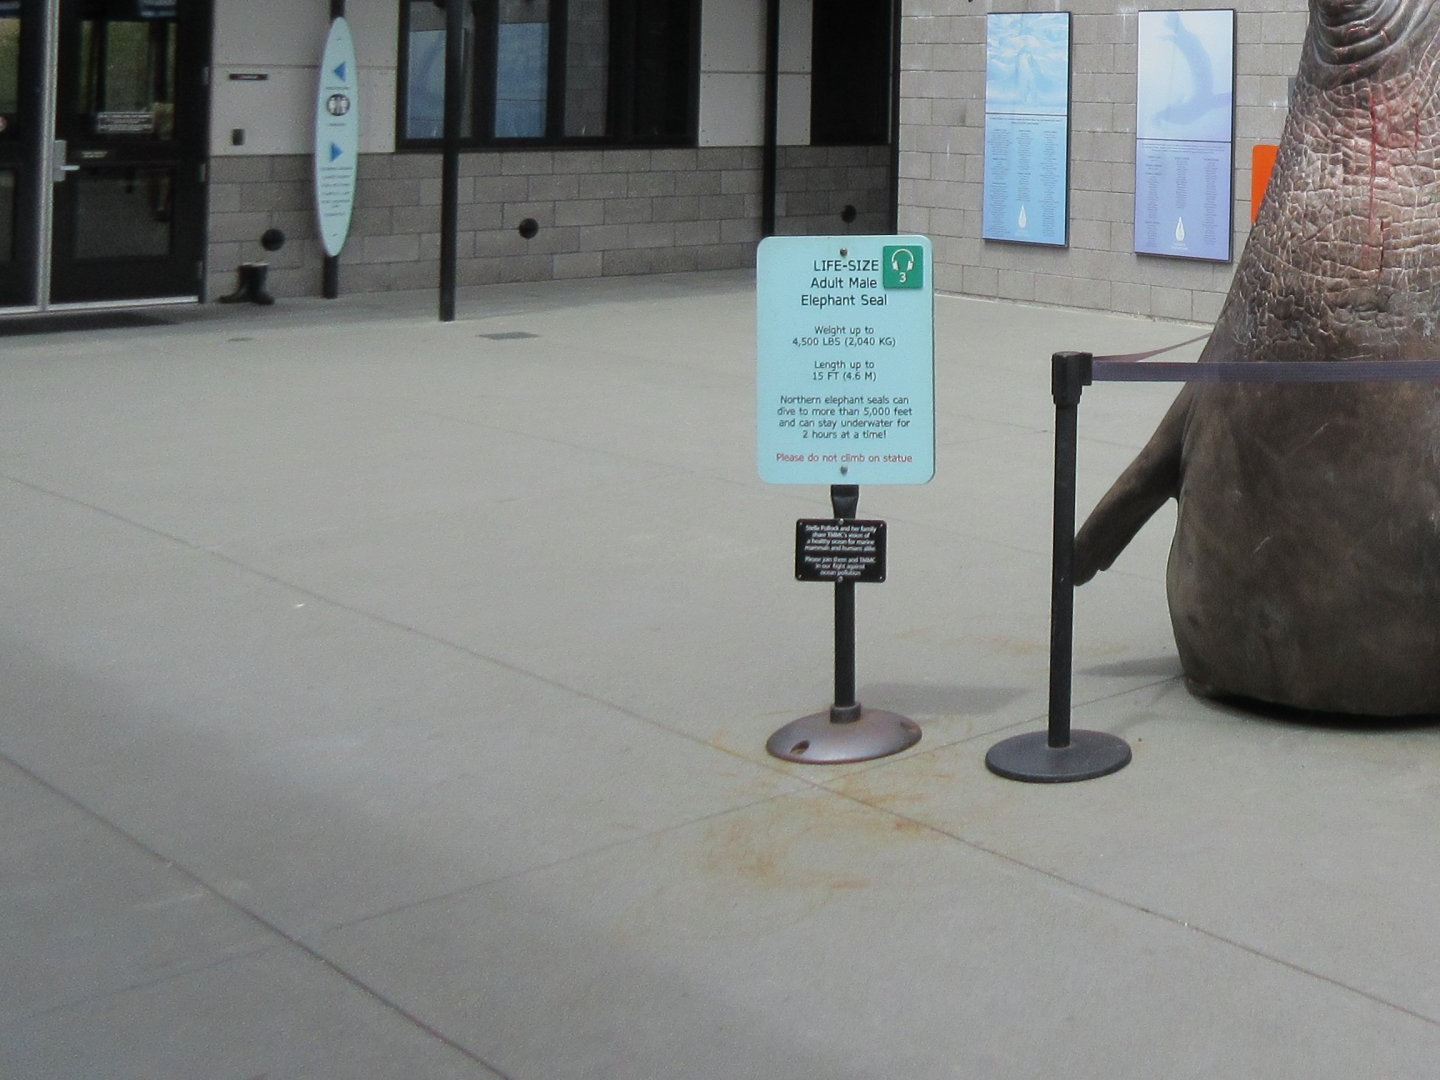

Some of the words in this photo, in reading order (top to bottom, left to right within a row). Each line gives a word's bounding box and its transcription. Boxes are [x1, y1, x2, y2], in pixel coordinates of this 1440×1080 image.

[813, 260, 880, 271] LIFE-SIZE
[811, 277, 843, 289] Adult
[849, 277, 877, 289] Male
[899, 272, 907, 283] 3
[801, 294, 855, 309] Elephant
[861, 294, 888, 306] Seal
[814, 326, 846, 338] Weight
[850, 328, 861, 338] up
[865, 326, 874, 334] to
[792, 337, 819, 347] 4,500
[823, 337, 841, 346] LBS
[844, 336, 875, 347] (2,040
[879, 337, 896, 347] KG)
[814, 360, 846, 371] Length
[850, 362, 861, 371] up
[865, 361, 875, 369] to
[812, 372, 824, 381] 15
[827, 372, 839, 380] FT
[843, 372, 861, 382] (4.6
[865, 372, 877, 382] M)
[780, 395, 821, 404] Northern
[824, 395, 864, 406] elephant
[867, 395, 890, 404] seals
[777, 407, 796, 416] dive
[799, 408, 809, 416] to
[839, 407, 860, 416] than
[863, 407, 890, 417] 5,000
[893, 407, 912, 416] feet
[778, 418, 796, 427] and
[818, 419, 838, 429] stay
[841, 418, 893, 428] underwater
[896, 418, 911, 428] for
[802, 430, 809, 438] 2
[812, 430, 838, 439] hours
[840, 431, 850, 439] at
[862, 430, 887, 439] time!
[776, 453, 805, 462] Please
[807, 453, 820, 462] do
[822, 454, 837, 462] not
[841, 453, 865, 462] climb
[883, 454, 913, 463] statue
